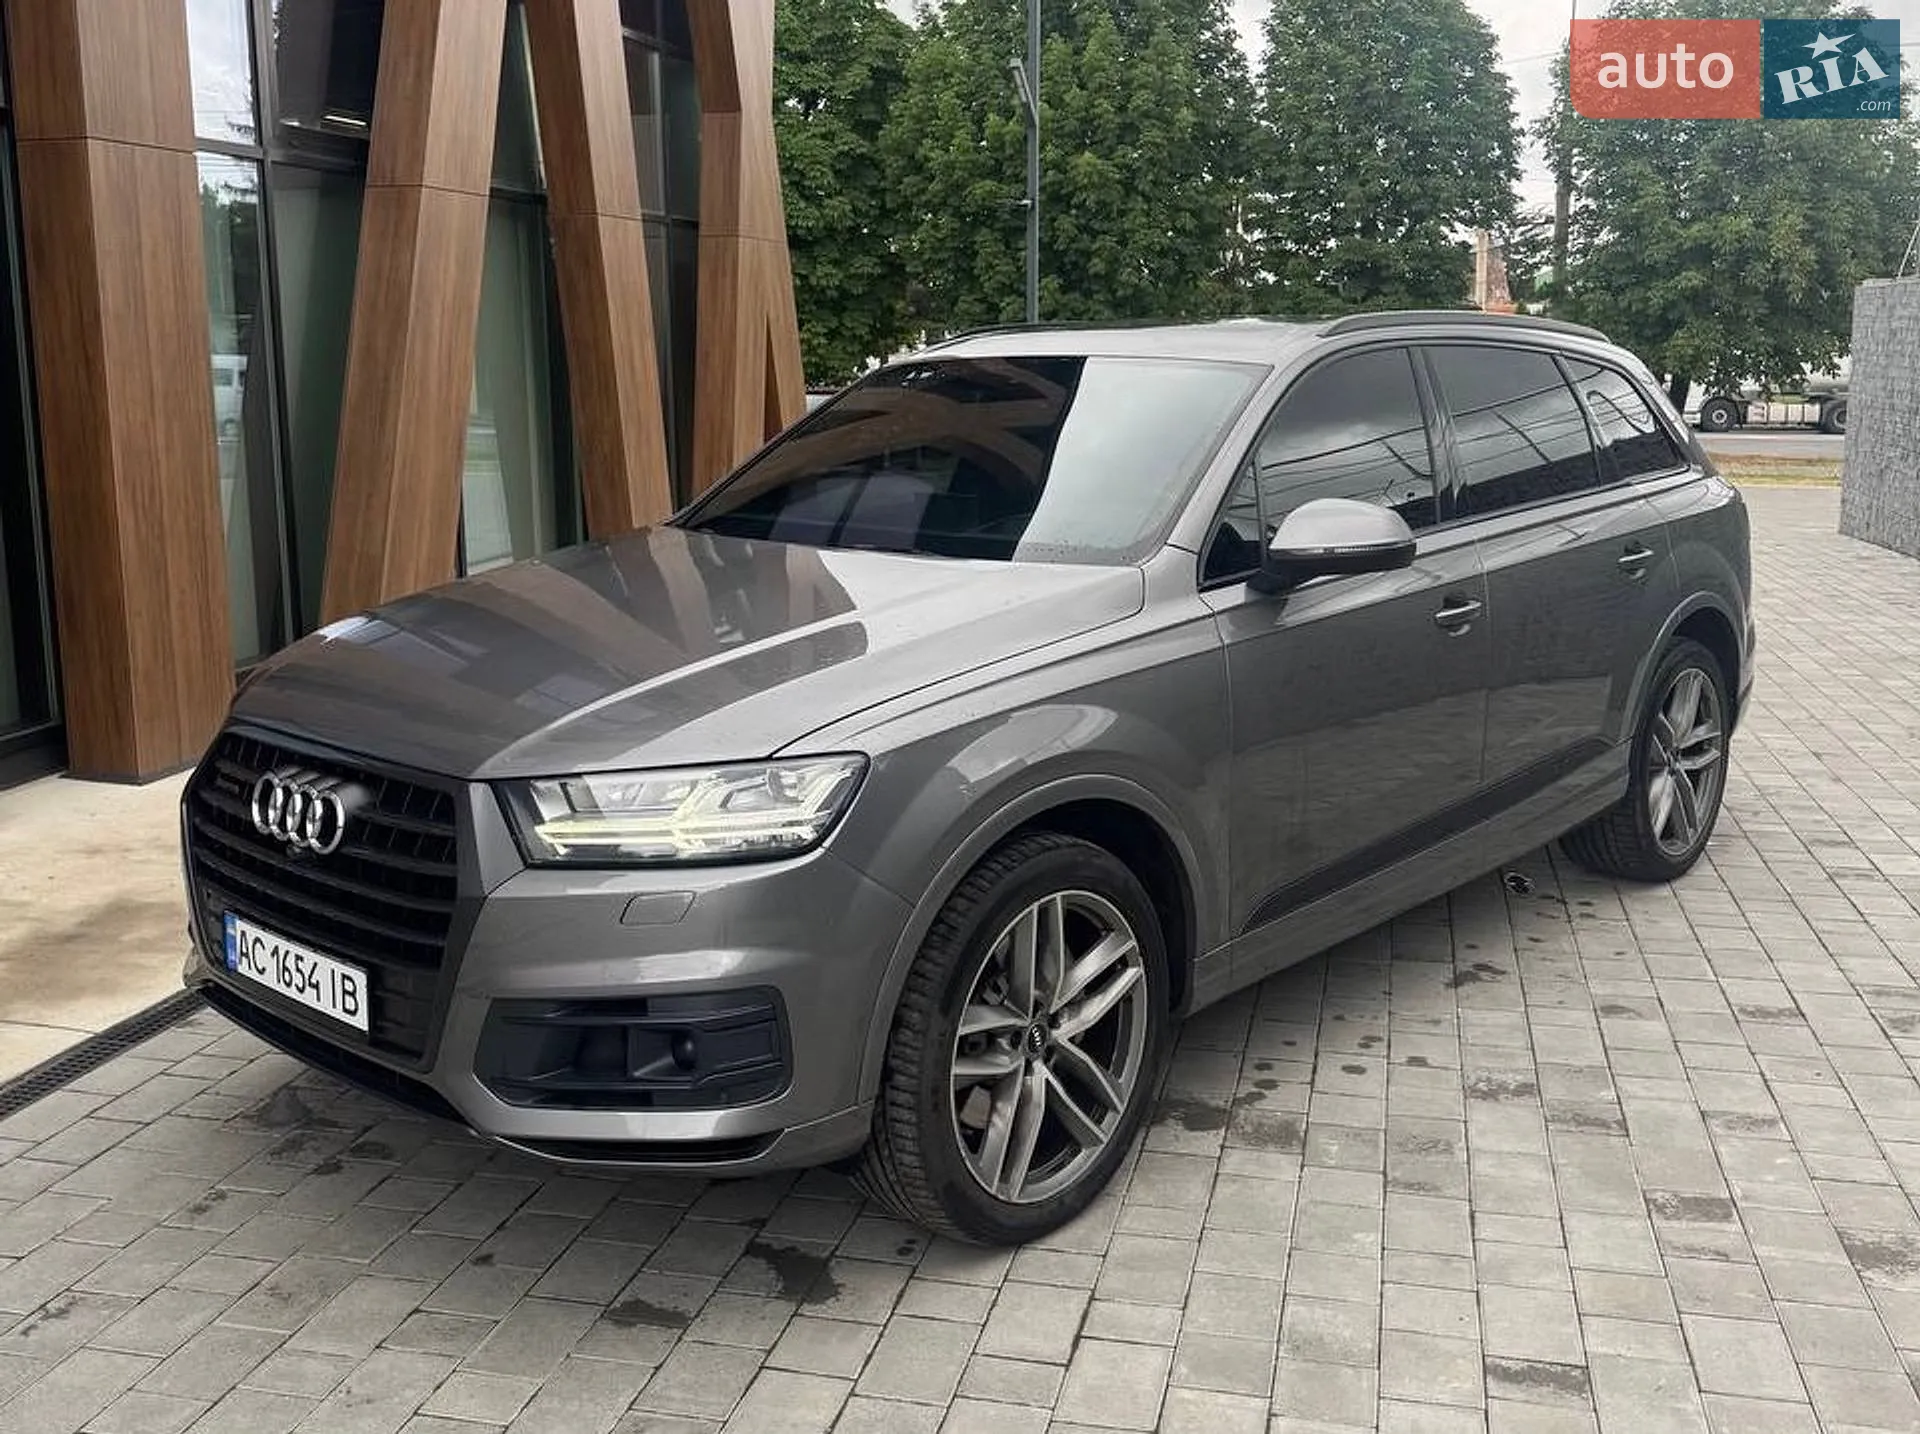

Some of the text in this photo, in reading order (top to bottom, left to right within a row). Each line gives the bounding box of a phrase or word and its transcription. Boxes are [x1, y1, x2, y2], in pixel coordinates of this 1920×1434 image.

[240, 930, 359, 1016] AC 1654 IB
